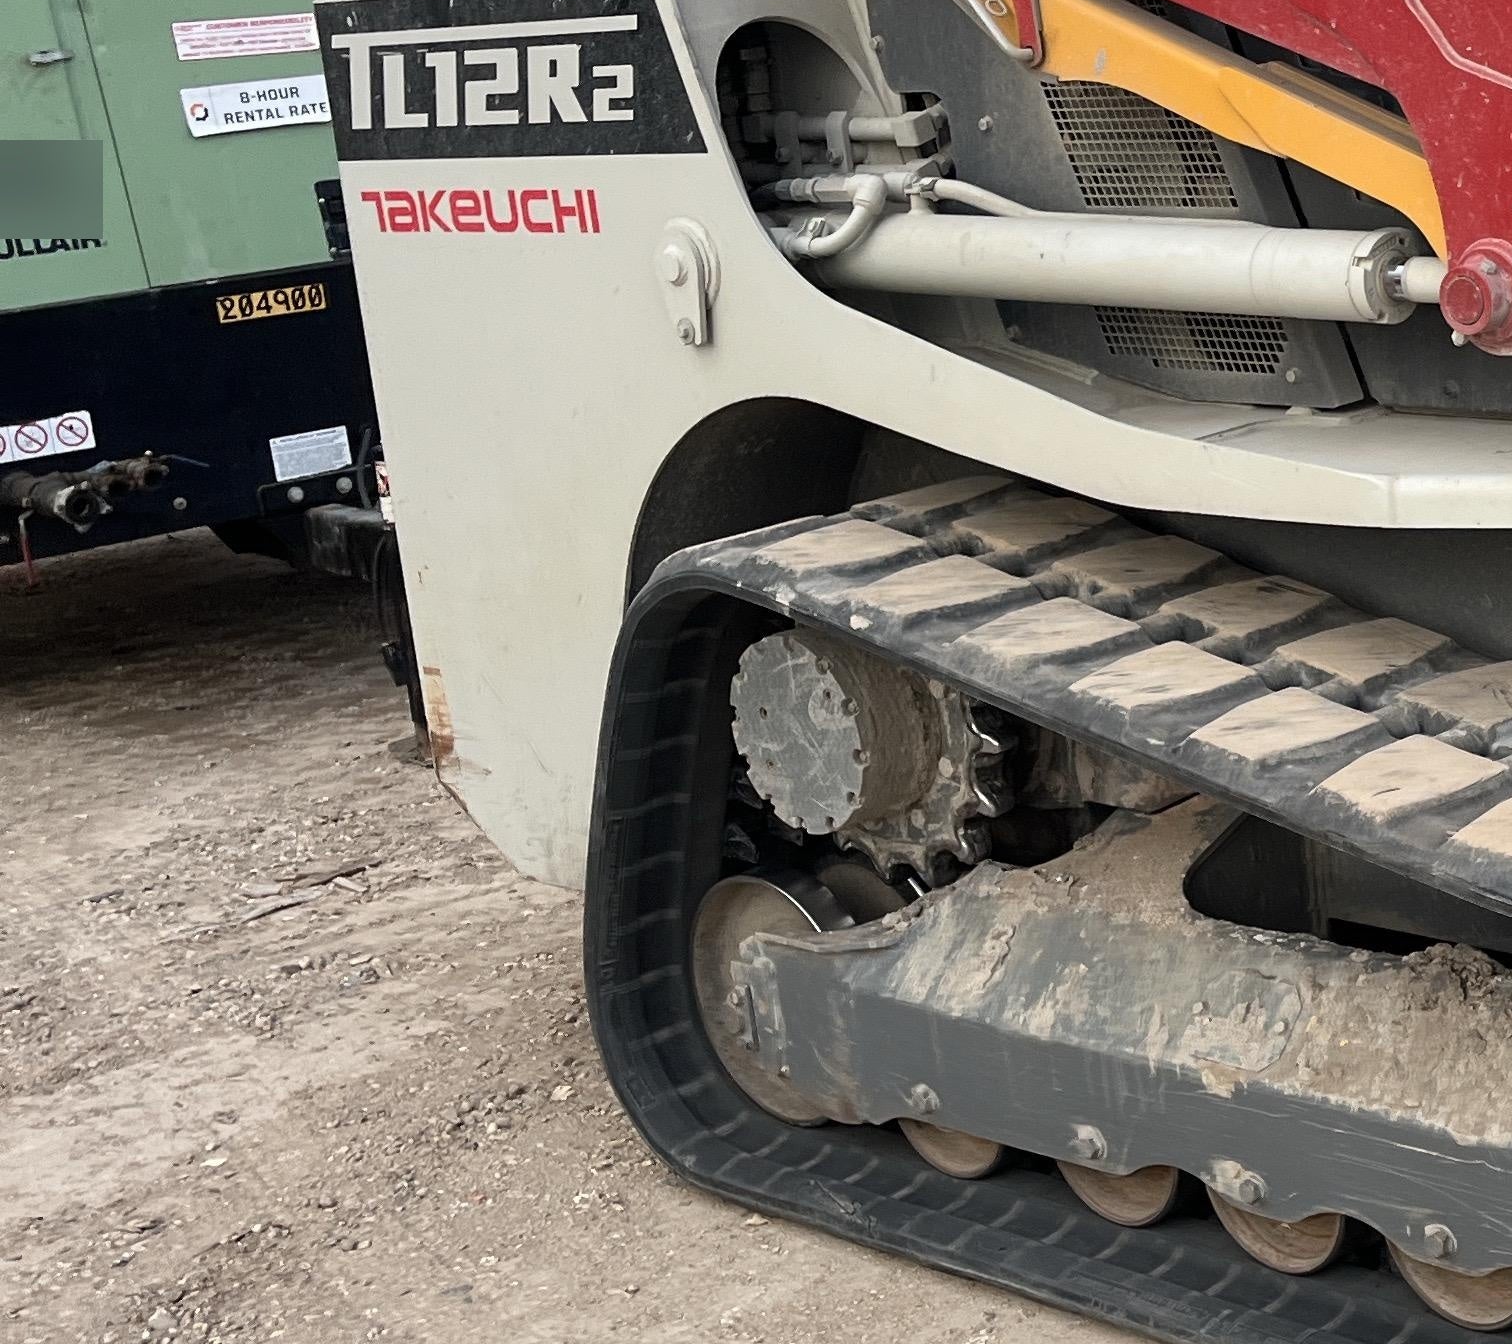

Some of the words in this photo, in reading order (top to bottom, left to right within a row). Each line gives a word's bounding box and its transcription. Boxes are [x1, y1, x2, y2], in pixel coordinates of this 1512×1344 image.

[332, 14, 638, 130] TL12R2
[239, 86, 300, 104] 8-HOUR
[223, 107, 285, 125] RENTAL
[289, 101, 329, 117] RATE
[218, 283, 325, 321] 204900
